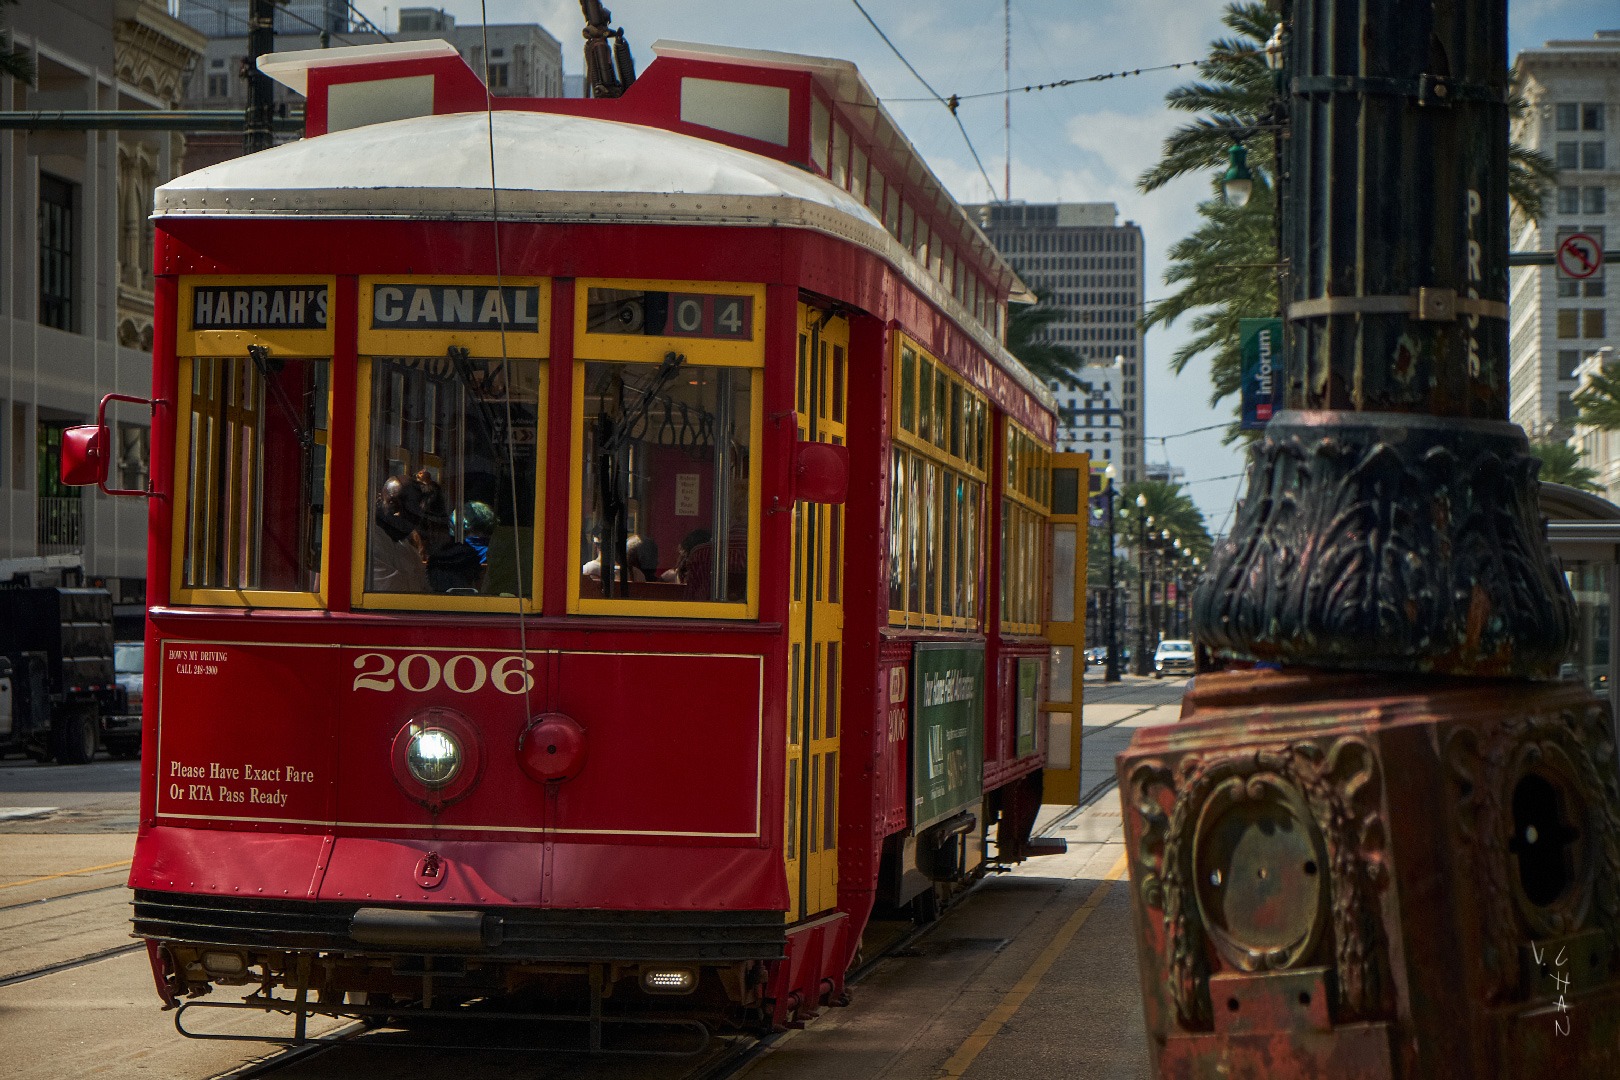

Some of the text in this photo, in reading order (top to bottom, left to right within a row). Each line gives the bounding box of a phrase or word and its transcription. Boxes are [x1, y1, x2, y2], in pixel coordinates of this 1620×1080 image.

[196, 290, 327, 324] HARRAH'S
[374, 286, 538, 324] CANAL
[1255, 329, 1273, 395] inforum
[168, 650, 228, 661] HOW'S MY DRIVING
[176, 664, 193, 674] CALL
[353, 653, 535, 695] 2006
[888, 708, 906, 743] 2006
[170, 761, 314, 783] Please Have Exact Fare
[169, 783, 288, 808] Or RTA Pass Ready
